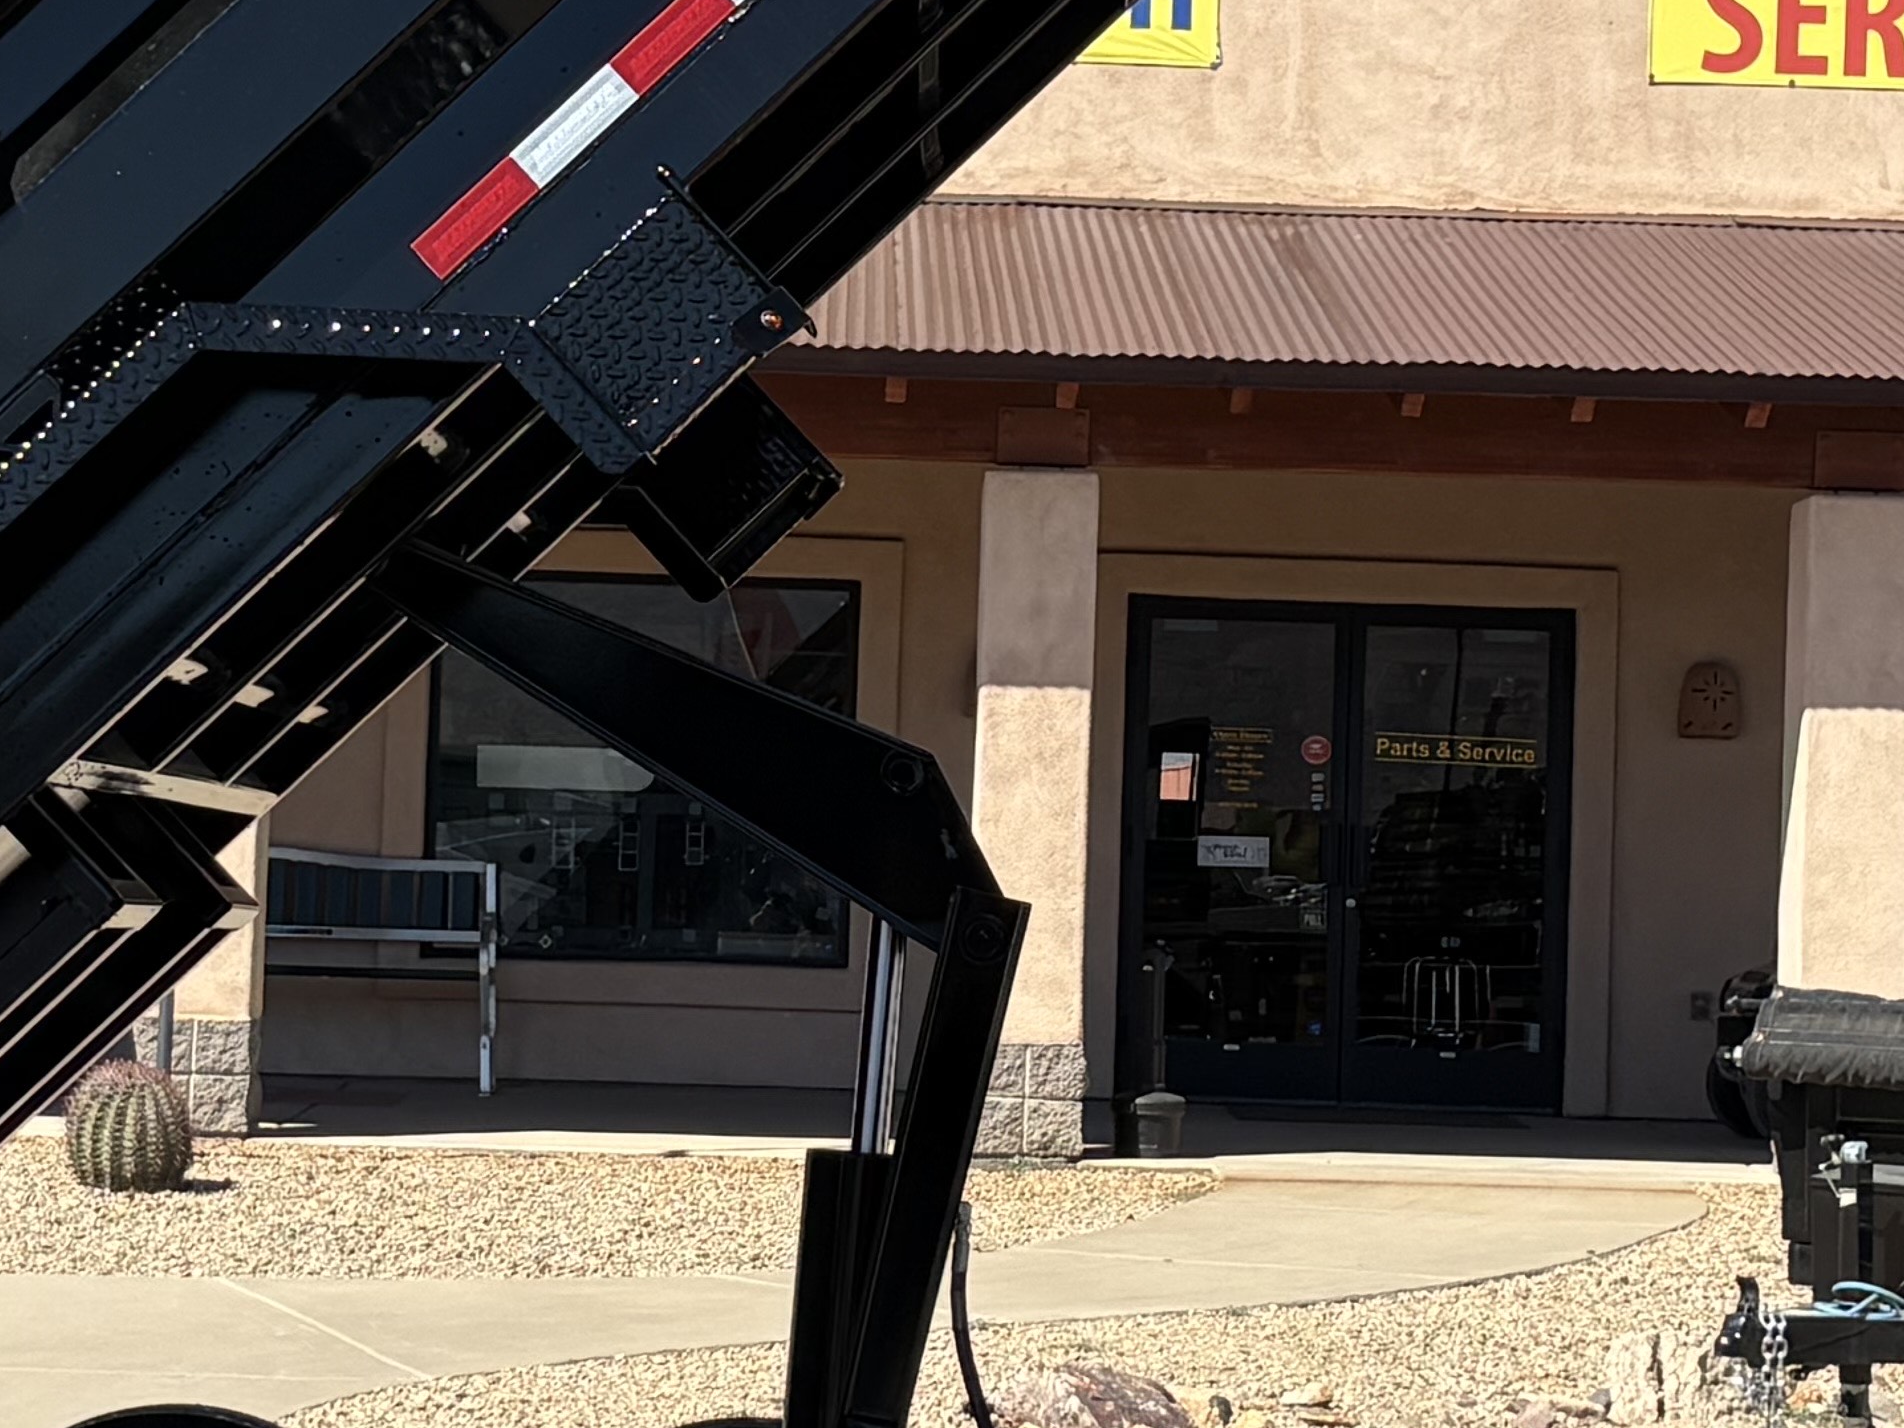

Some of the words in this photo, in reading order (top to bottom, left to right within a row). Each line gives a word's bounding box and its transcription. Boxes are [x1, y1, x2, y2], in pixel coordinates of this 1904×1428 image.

[1375, 736, 1431, 759] Parts
[1436, 740, 1452, 760] &
[1457, 740, 1536, 764] Service
